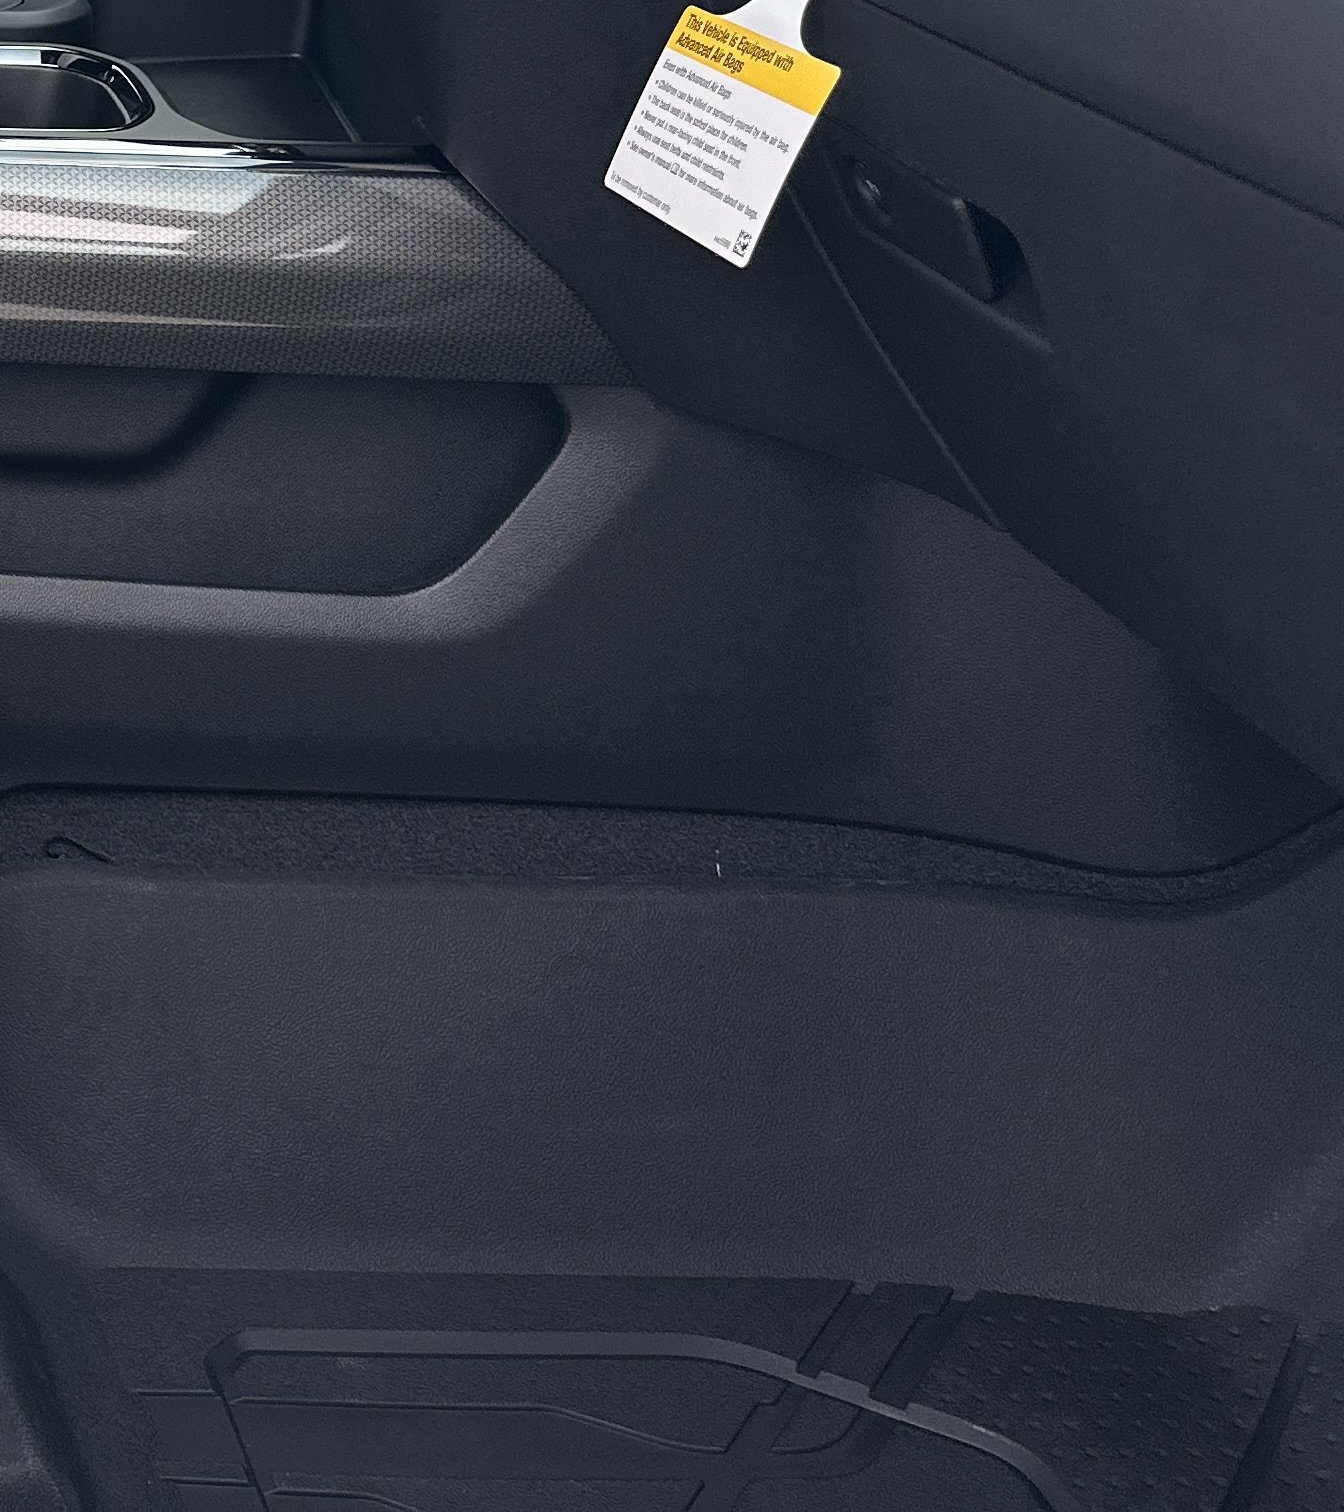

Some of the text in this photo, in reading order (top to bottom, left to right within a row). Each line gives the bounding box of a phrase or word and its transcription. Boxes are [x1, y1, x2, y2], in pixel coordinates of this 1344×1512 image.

[677, 33, 712, 57] Advanced
[723, 52, 743, 73] Bags
[686, 13, 702, 31] This
[702, 22, 729, 42] Vehicle
[737, 36, 774, 62] Equipped
[774, 55, 793, 70] with
